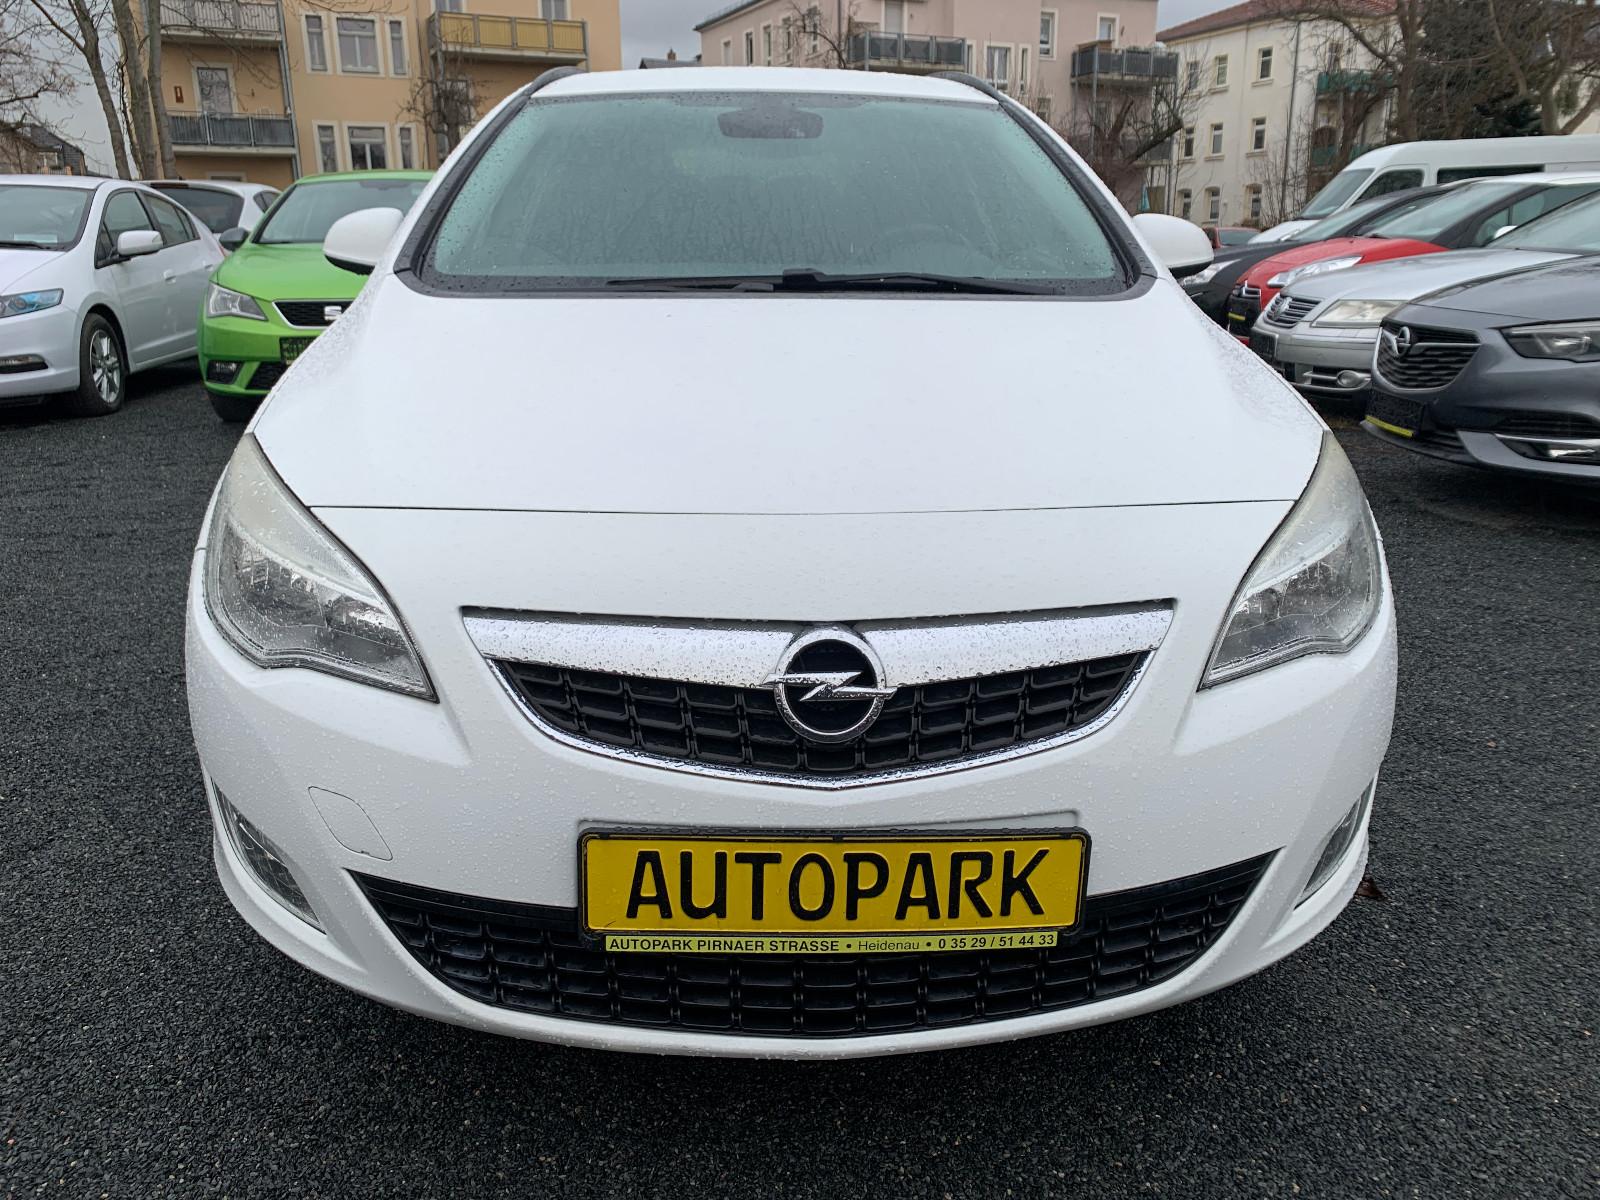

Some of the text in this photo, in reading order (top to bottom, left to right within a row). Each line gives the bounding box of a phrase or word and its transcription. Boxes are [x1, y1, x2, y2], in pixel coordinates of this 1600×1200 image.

[626, 849, 1050, 921] AUTOPARK
[609, 938, 693, 951] AUTOPARK
[697, 939, 763, 952] PIRNAER
[769, 940, 839, 952] STRASSE
[858, 940, 920, 951] Heidenau
[950, 938, 967, 949] 35
[970, 937, 987, 948] 29
[998, 936, 1014, 947] 51
[1018, 935, 1034, 947] 44
[1038, 934, 1054, 946] 33
